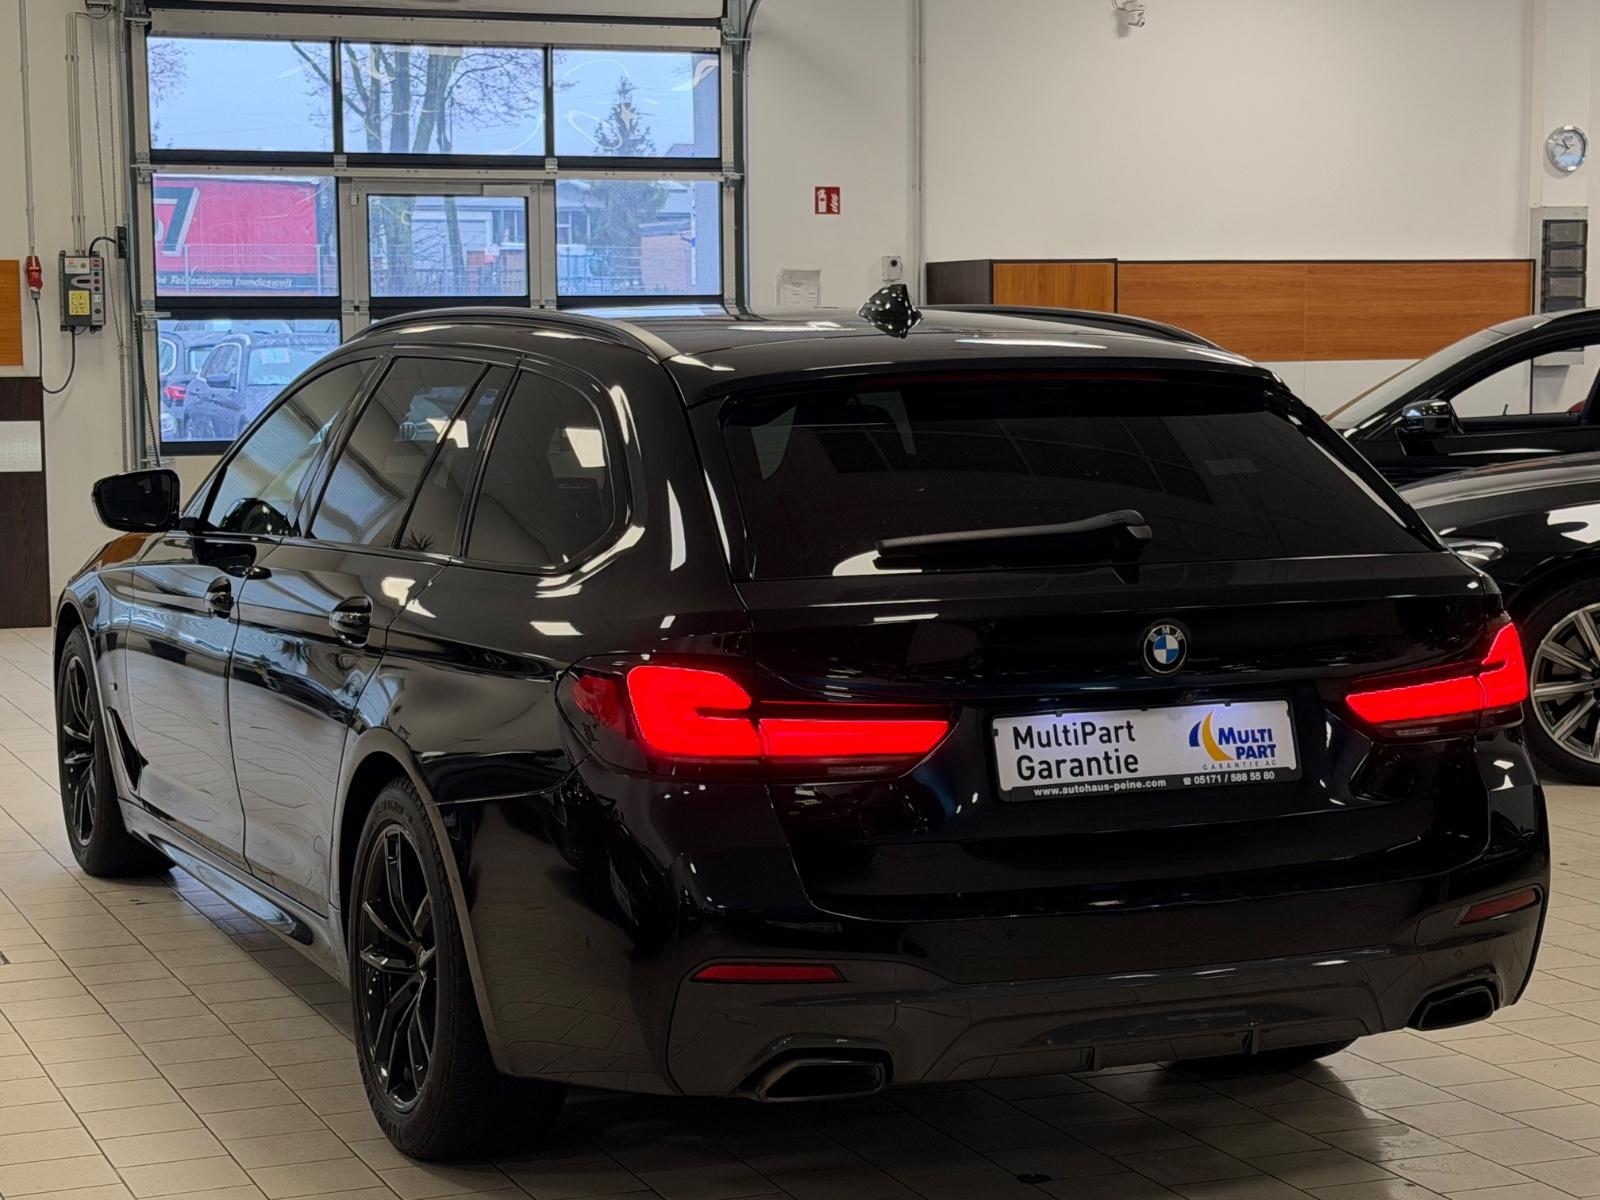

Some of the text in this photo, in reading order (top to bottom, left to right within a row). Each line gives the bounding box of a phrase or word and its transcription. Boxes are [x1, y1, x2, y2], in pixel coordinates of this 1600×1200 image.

[1149, 626, 1185, 642] BMW
[1012, 720, 1136, 750] MultiPart
[1218, 727, 1274, 745] MULTI
[1235, 744, 1277, 760] PART
[1016, 748, 1139, 781] Garantie
[1202, 760, 1259, 771] GARANTIE
[1194, 773, 1222, 785] 05171
[1250, 770, 1262, 780] 55
[1263, 769, 1275, 780] 80
[1033, 778, 1167, 796] www.autohaus-peine.com
